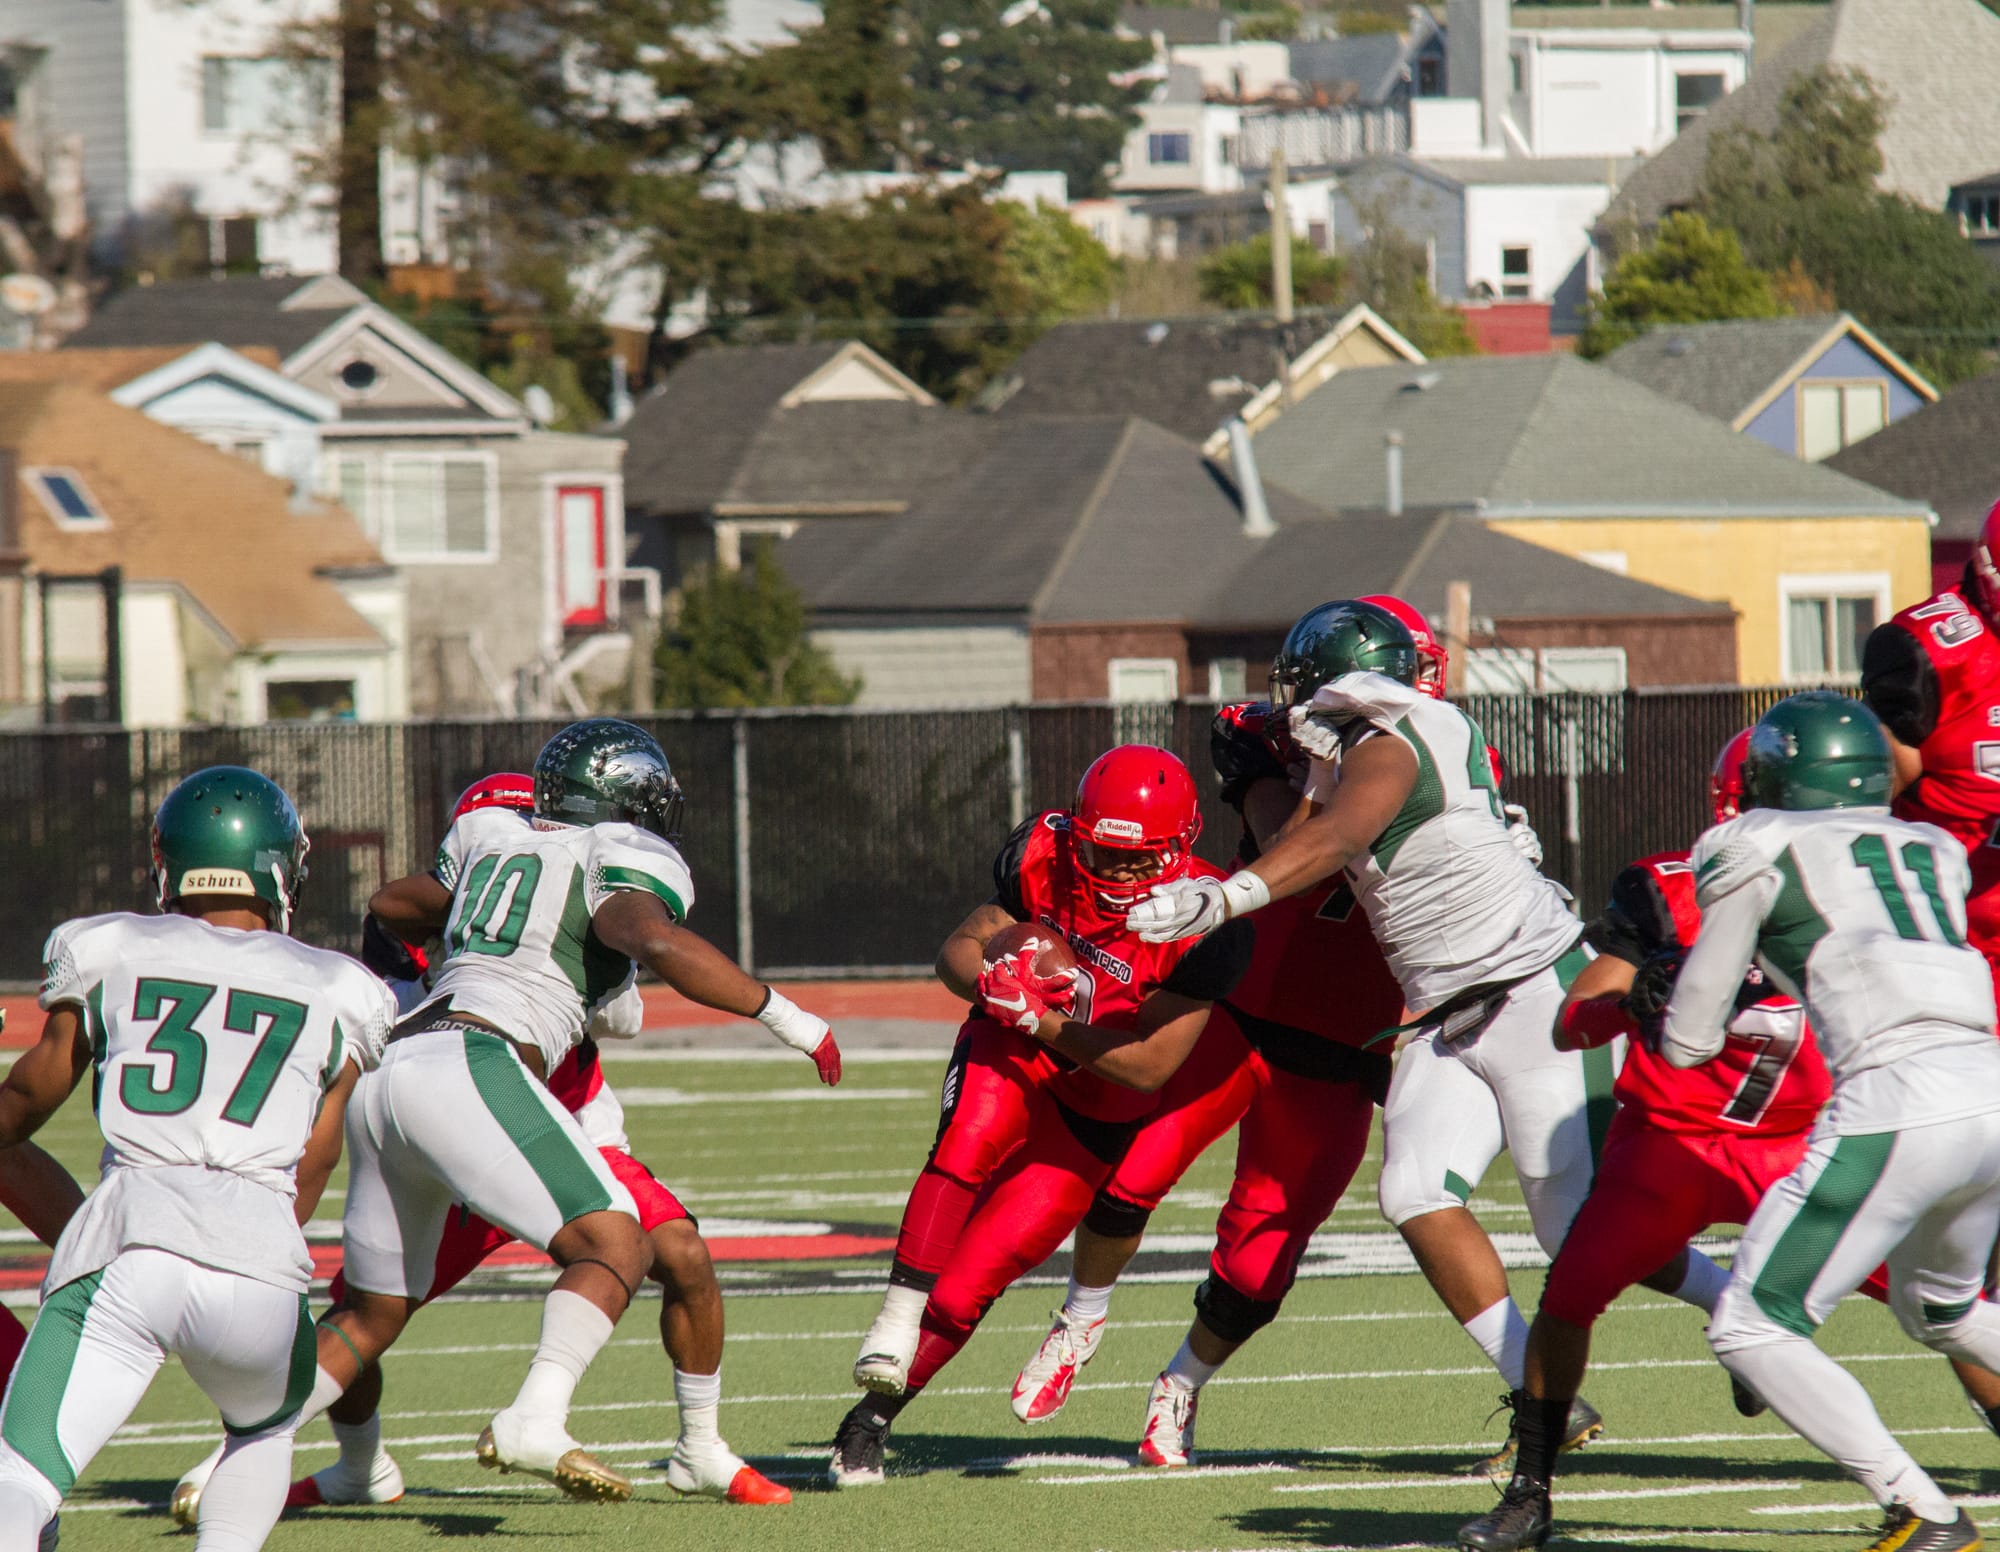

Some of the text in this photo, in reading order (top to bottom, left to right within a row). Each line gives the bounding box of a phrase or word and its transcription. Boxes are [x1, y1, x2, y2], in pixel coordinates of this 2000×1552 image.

[1107, 821, 1132, 832] Riddell
[188, 874, 242, 887] schutt
[450, 852, 543, 958] 10
[1850, 833, 1972, 952] 11
[1068, 933, 1132, 985] FRANCISCO
[119, 976, 309, 1128] 37
[1717, 1003, 1804, 1127] 7
